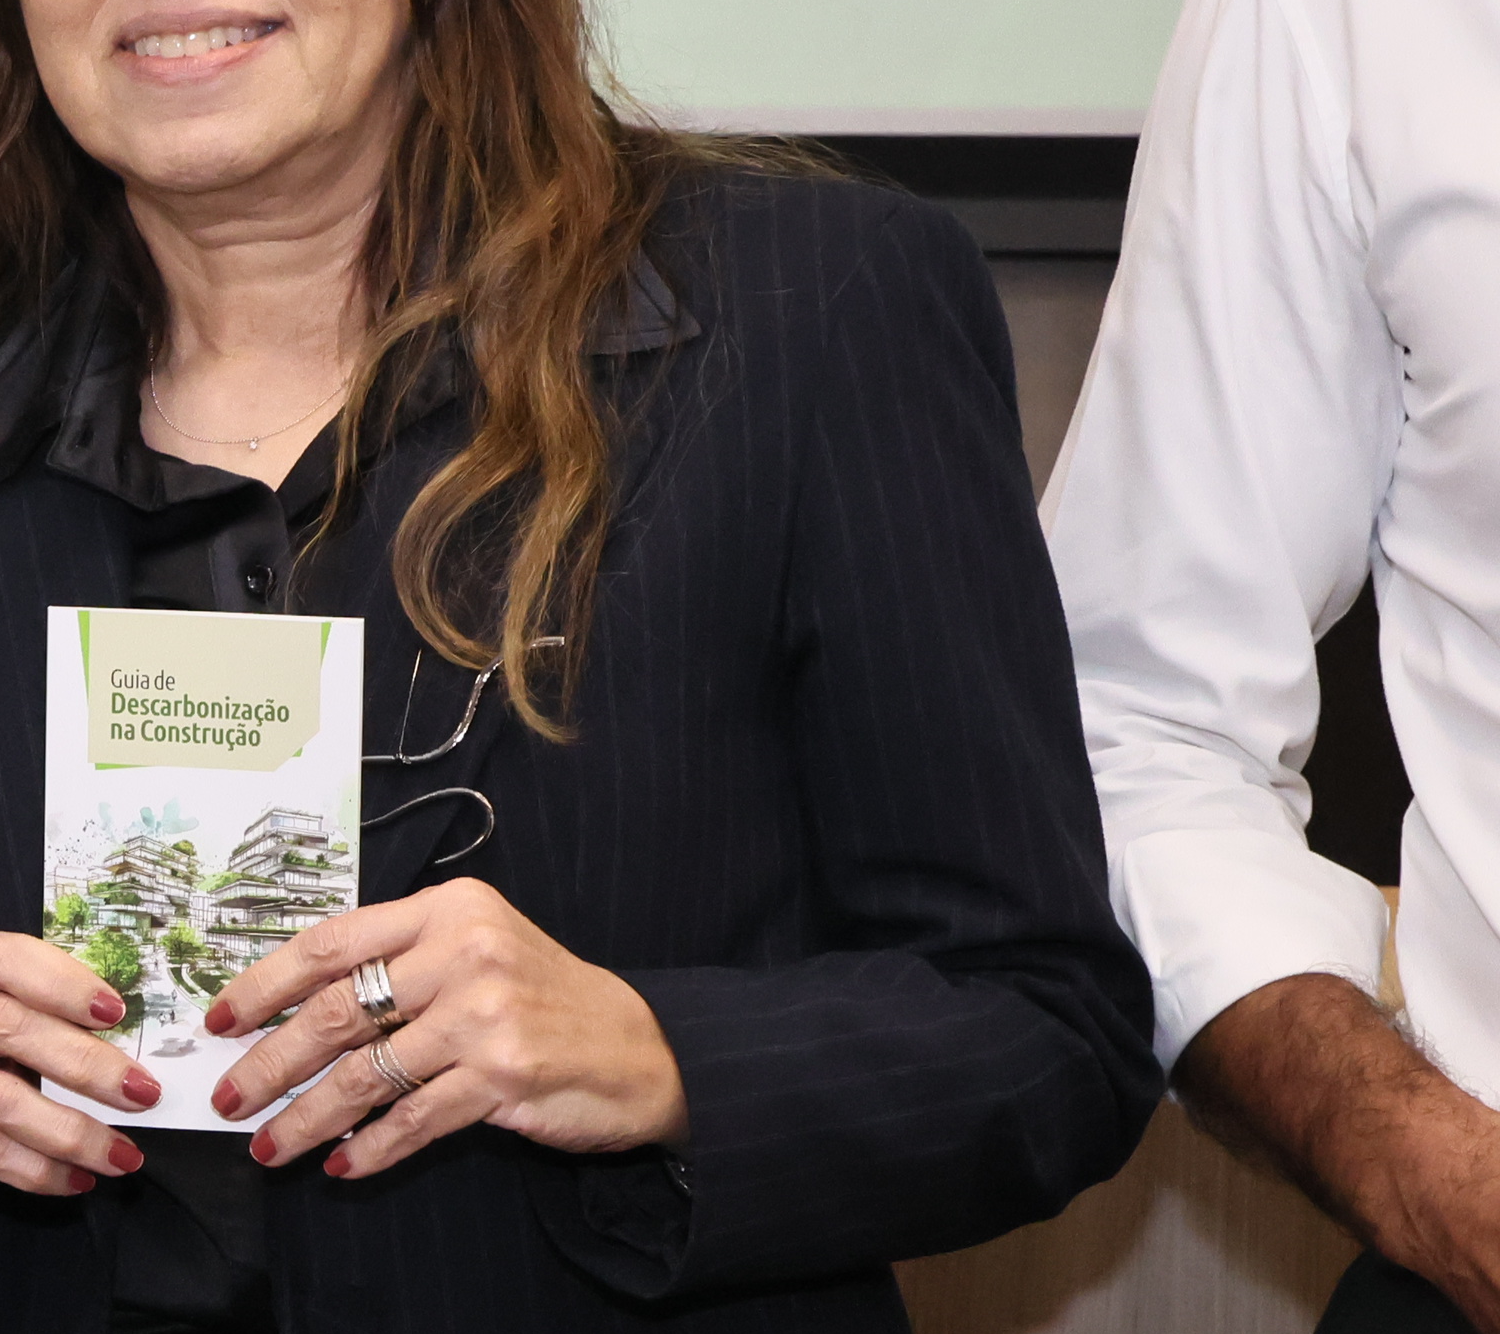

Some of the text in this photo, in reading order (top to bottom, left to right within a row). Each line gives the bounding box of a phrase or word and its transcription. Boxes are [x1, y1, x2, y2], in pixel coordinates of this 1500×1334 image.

[110, 669, 174, 690] Guia de
[111, 691, 289, 725] Descarbonização
[110, 719, 261, 750] na Construção
